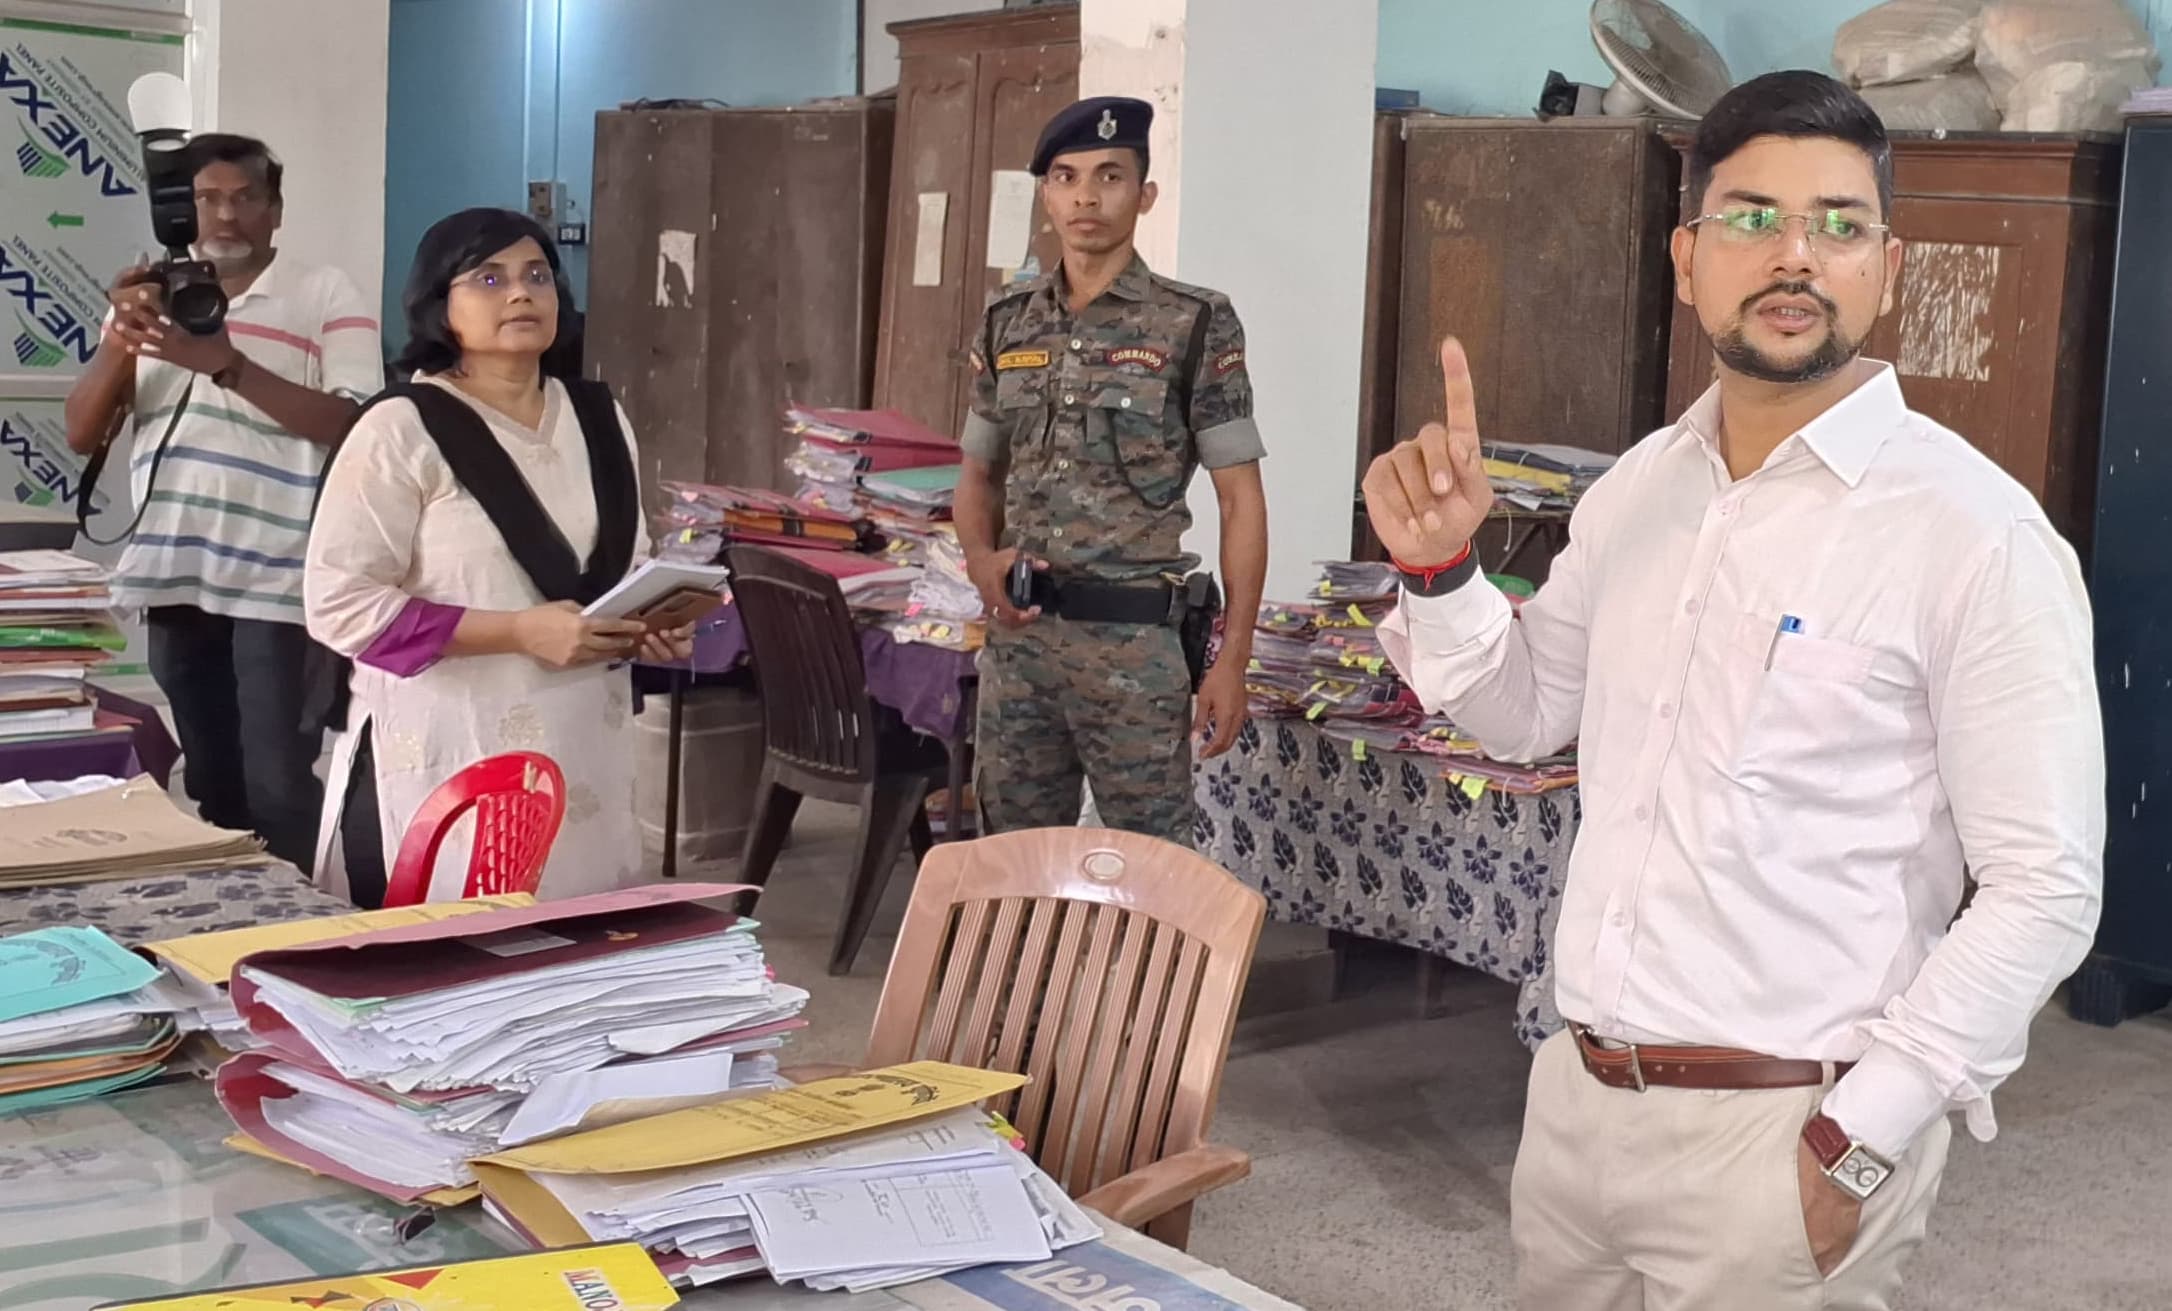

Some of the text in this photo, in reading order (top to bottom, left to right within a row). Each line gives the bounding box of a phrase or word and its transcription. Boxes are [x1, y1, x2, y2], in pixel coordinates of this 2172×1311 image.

[15, 42, 47, 76] PANEL
[45, 75, 98, 130] COMPOSITE
[0, 52, 138, 197] ANEXA
[12, 234, 42, 267] PANEL
[0, 246, 99, 364] NEXA
[1111, 349, 1161, 367] COMMANDO
[563, 1269, 619, 1311] MANO
